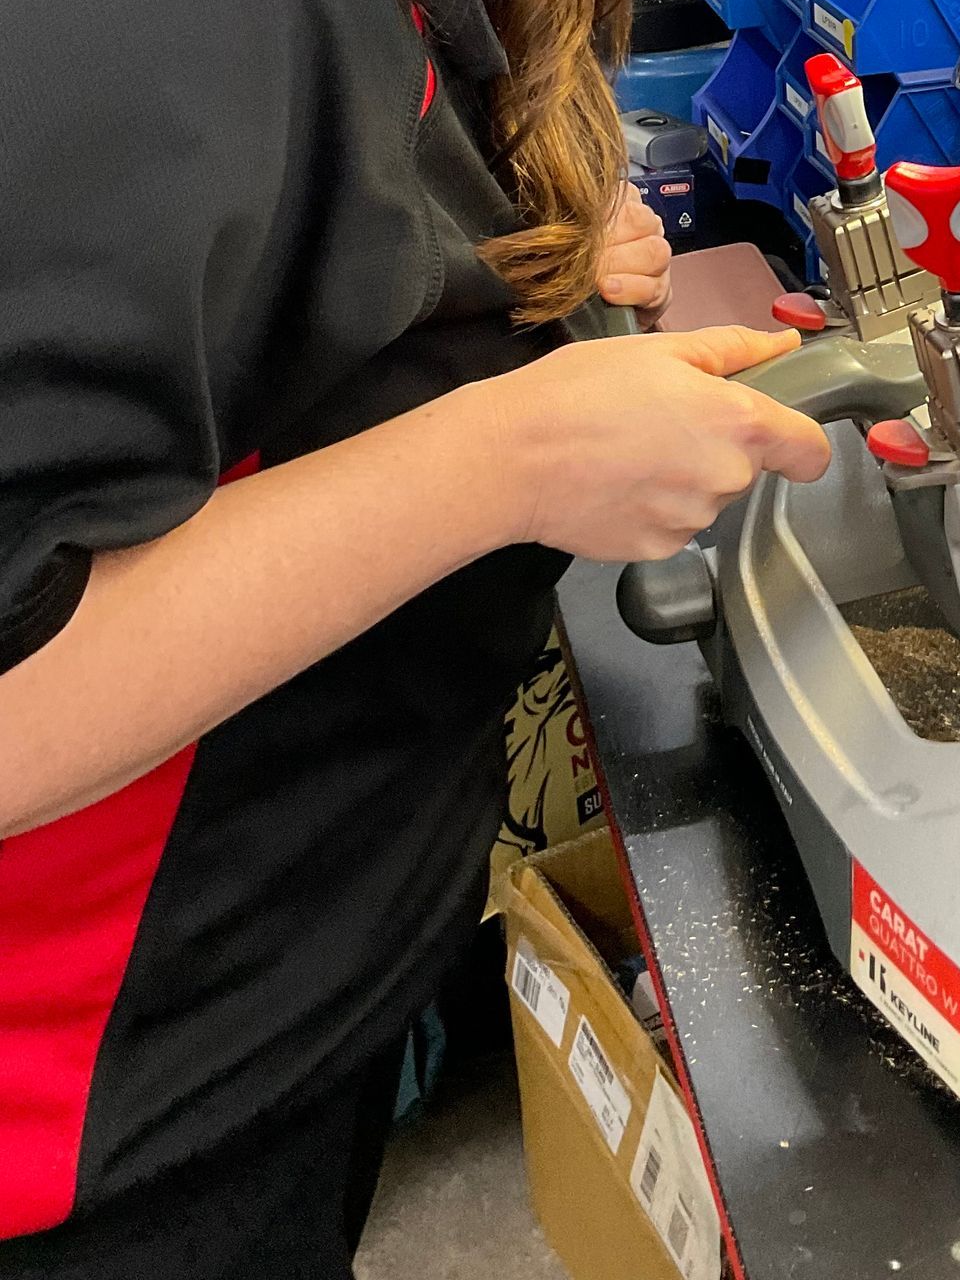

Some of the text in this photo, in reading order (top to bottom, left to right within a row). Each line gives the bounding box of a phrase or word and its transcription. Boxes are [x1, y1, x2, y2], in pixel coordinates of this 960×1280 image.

[868, 889, 930, 961] CARAT
[868, 916, 959, 1017] QUATTRO W
[890, 989, 941, 1054] KEYLINE
